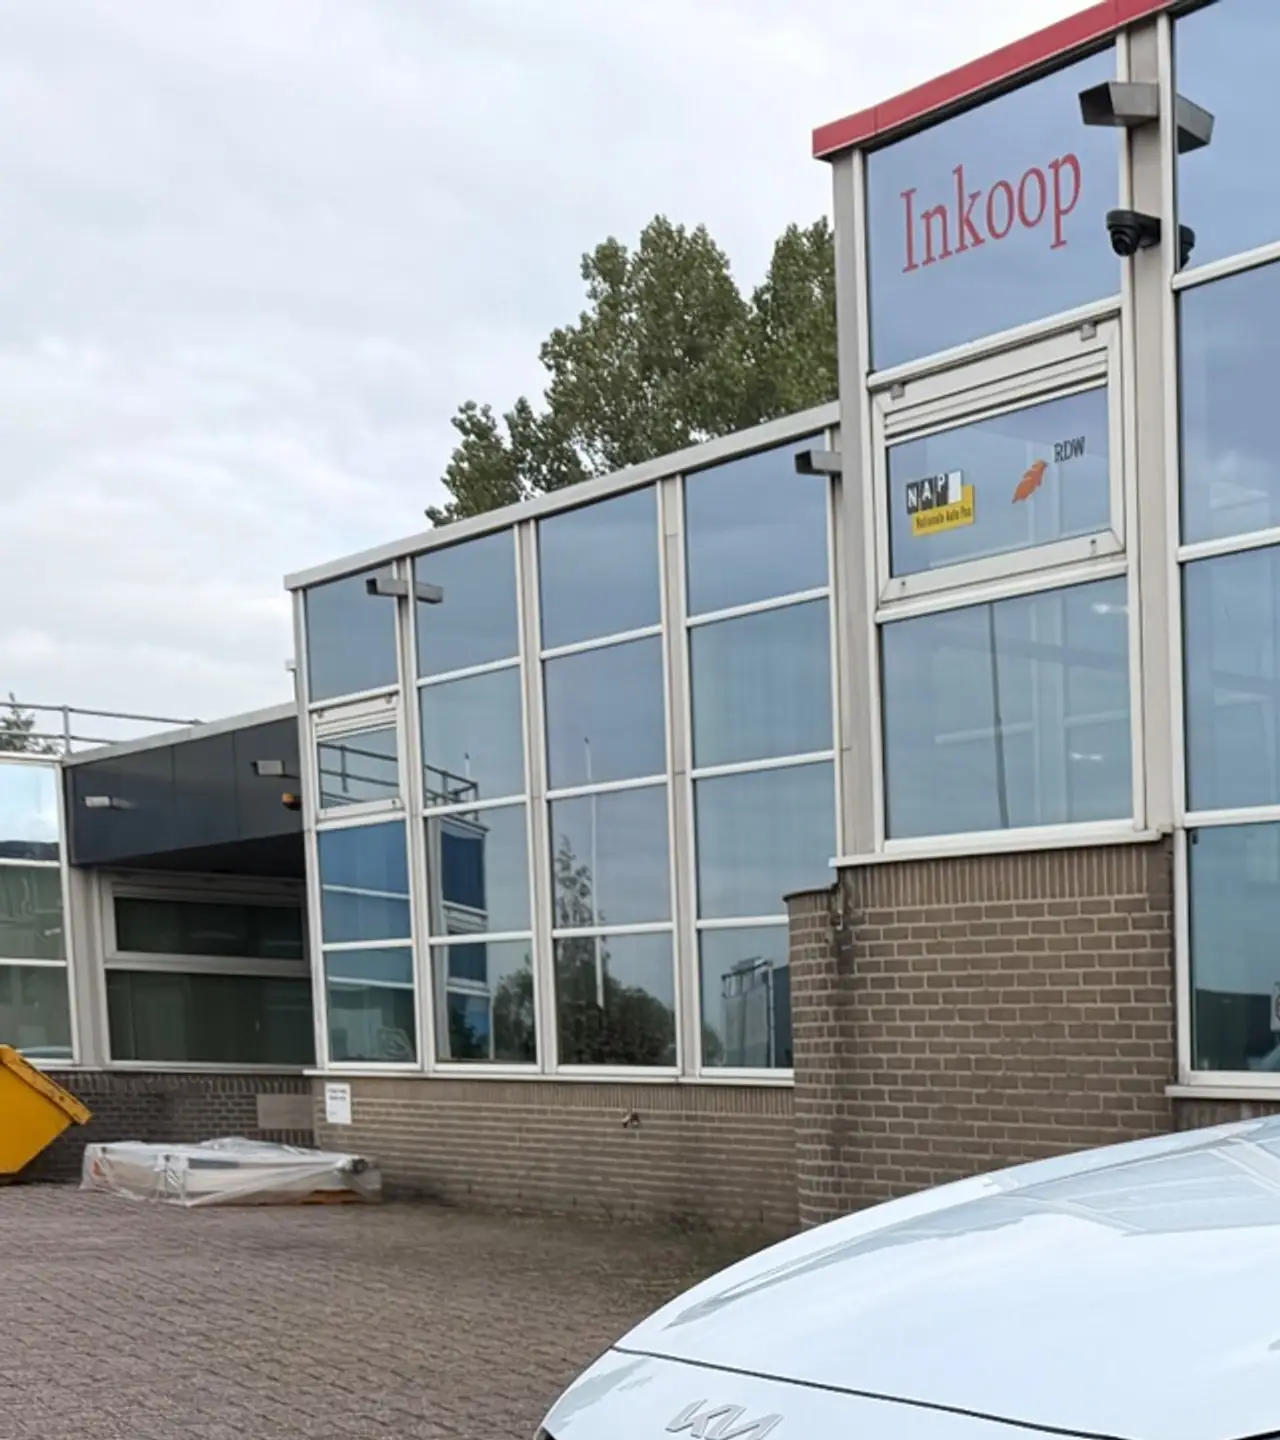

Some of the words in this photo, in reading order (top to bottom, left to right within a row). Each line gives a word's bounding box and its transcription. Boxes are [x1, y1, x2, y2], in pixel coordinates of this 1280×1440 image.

[900, 153, 1081, 273] Inkoop
[1053, 436, 1086, 464] RDW
[907, 473, 946, 508] NAP
